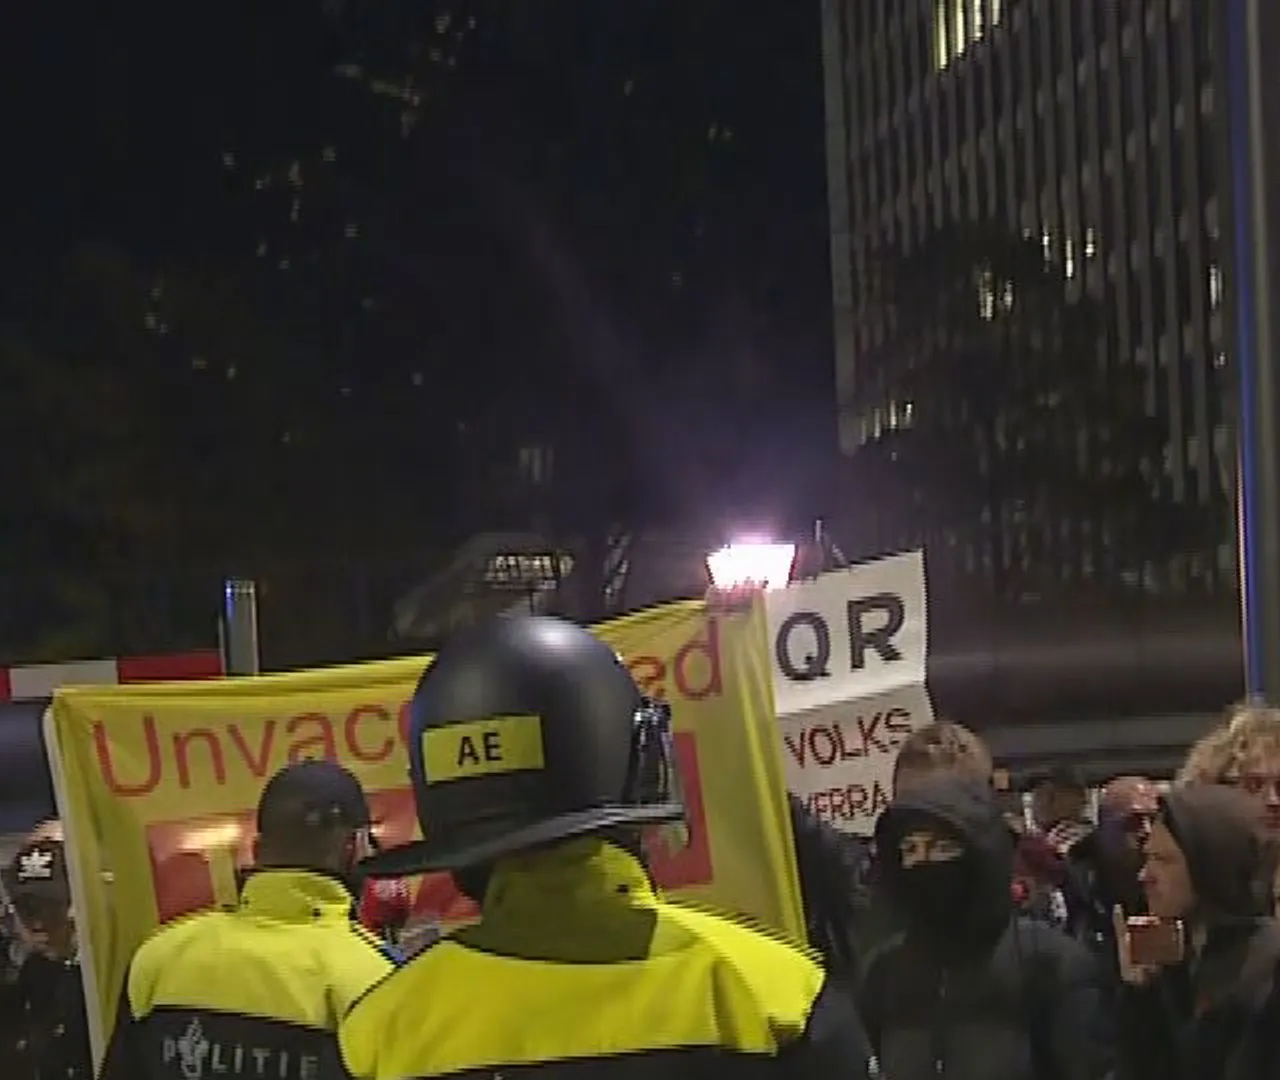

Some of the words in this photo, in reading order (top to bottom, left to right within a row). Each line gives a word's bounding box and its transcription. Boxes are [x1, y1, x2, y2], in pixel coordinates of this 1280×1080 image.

[776, 592, 905, 681] QR
[457, 731, 503, 768] AE
[785, 708, 912, 769] VOLKS
